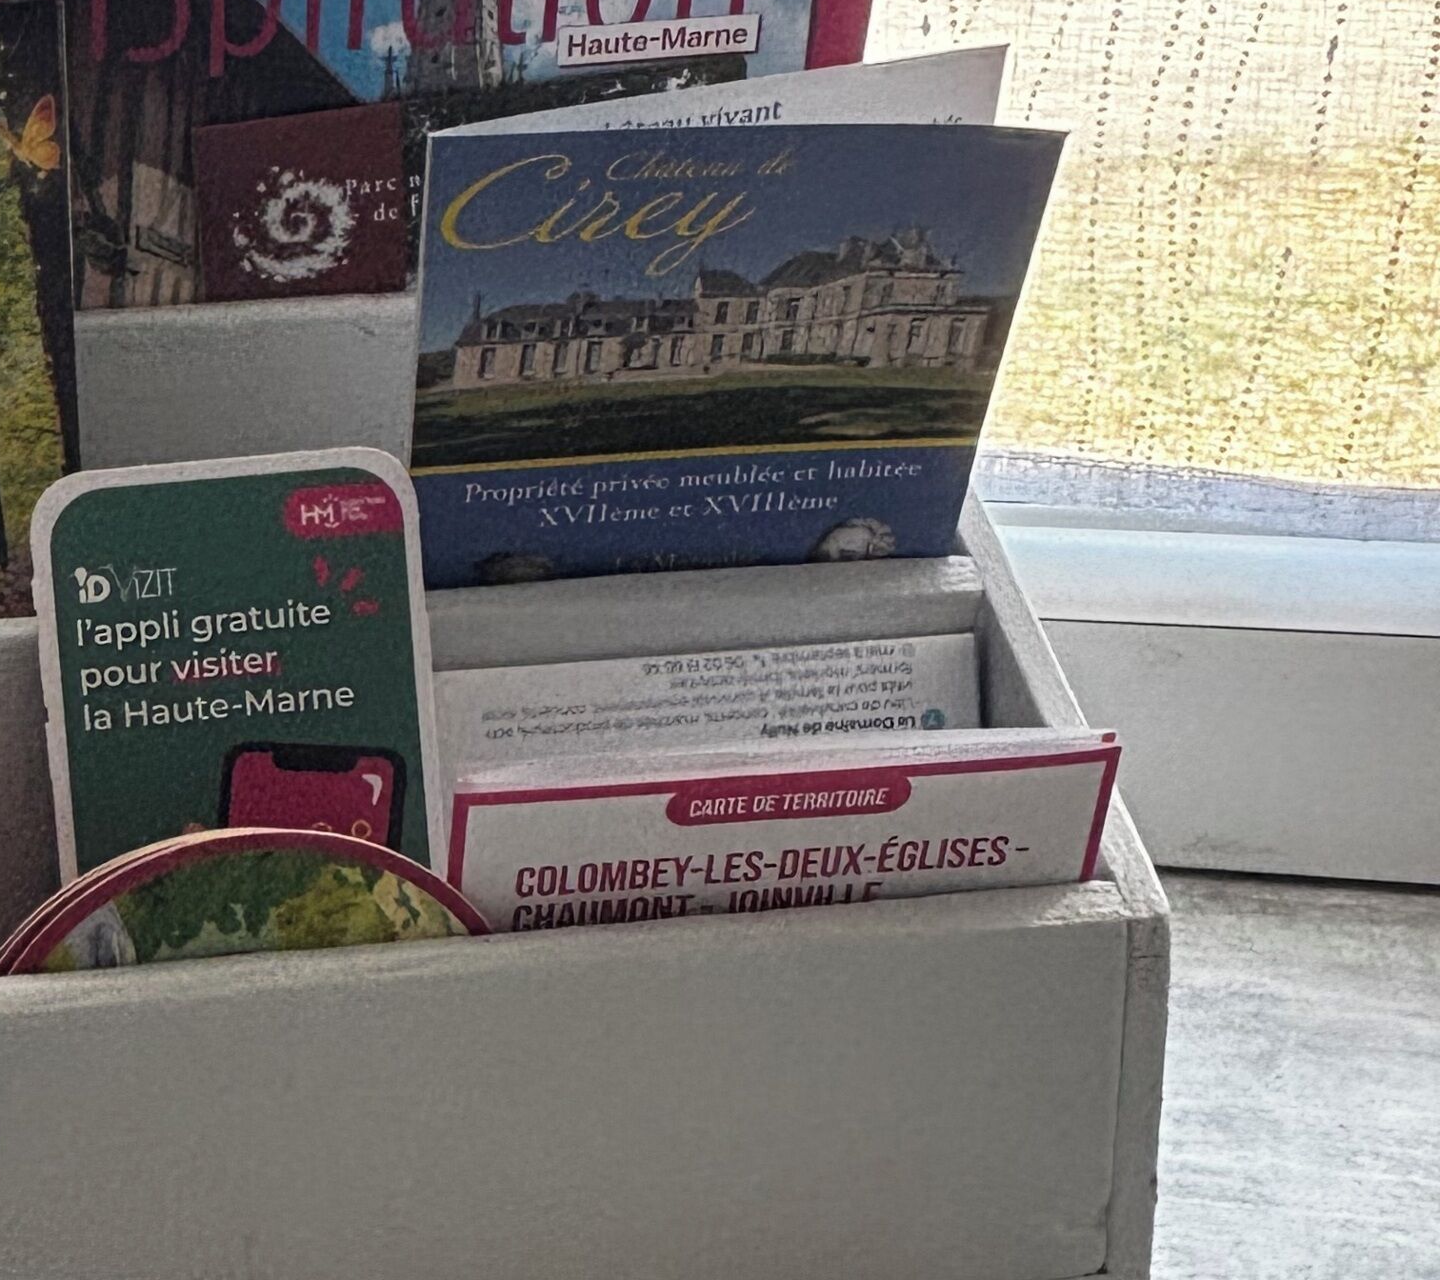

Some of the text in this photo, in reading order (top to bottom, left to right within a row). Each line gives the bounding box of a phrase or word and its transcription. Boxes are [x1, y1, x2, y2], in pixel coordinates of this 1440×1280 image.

[566, 22, 749, 59] Haute-Marne
[345, 176, 398, 196] Parc
[440, 152, 757, 277] Cirey
[190, 598, 332, 644] gratuite
[79, 647, 279, 696] pour visiter
[83, 686, 355, 732] la Haute-Marne
[689, 787, 890, 818] CARTE DE TERRITOIRE
